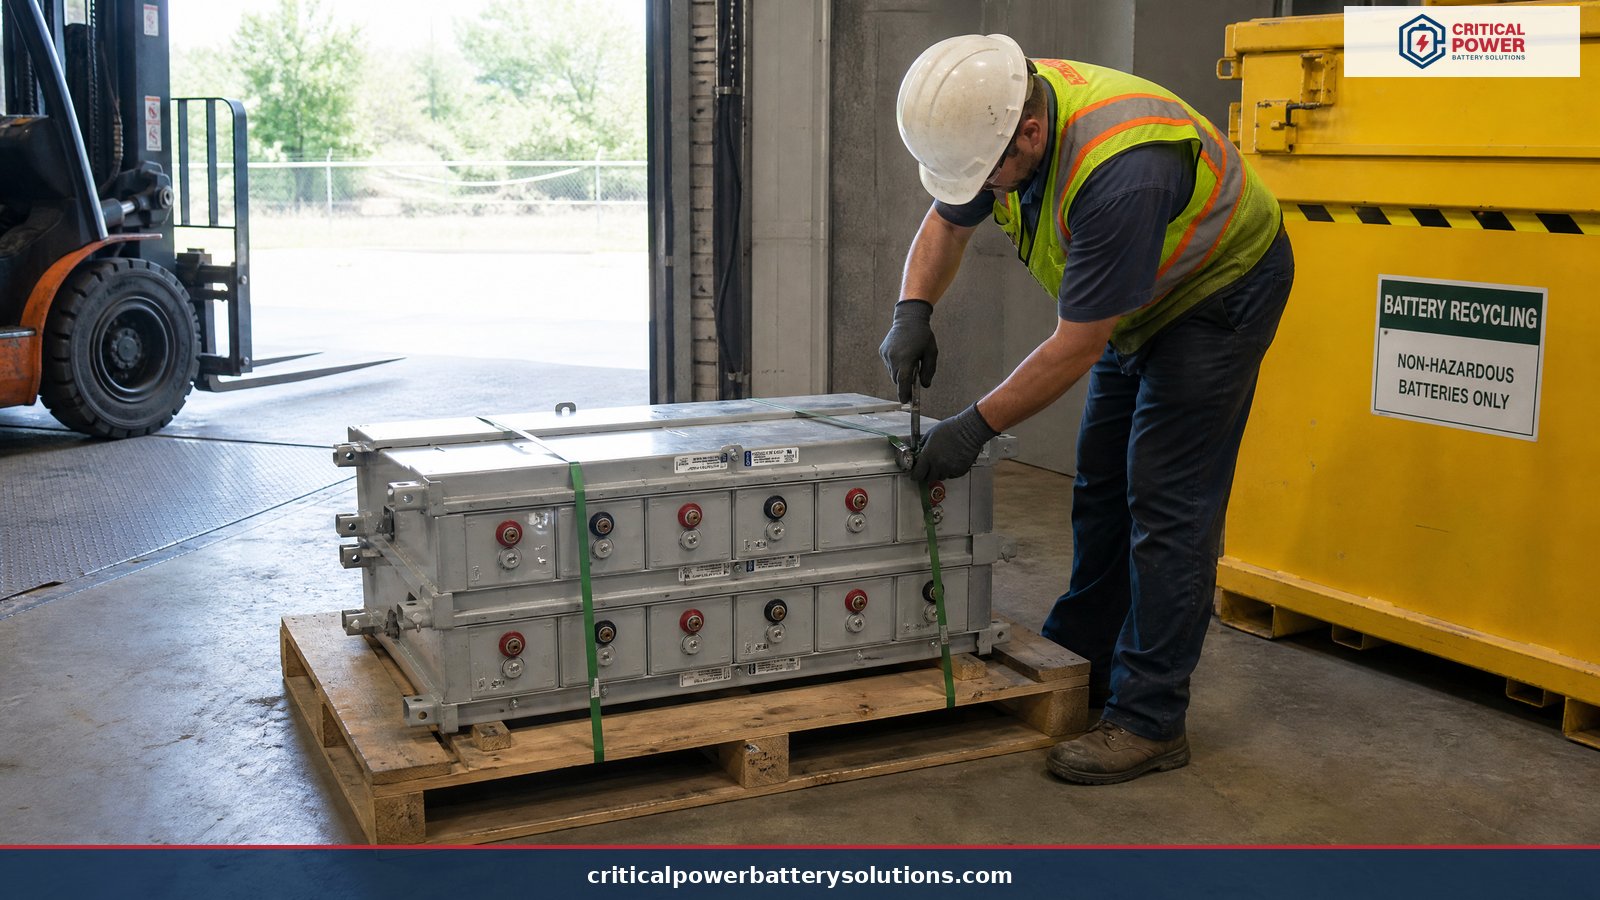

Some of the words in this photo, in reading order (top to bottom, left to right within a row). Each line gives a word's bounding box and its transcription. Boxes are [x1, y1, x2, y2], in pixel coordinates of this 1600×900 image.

[1384, 294, 1447, 319] BATTERY
[1450, 300, 1537, 329] RECYCLING
[1397, 353, 1514, 383] NON-HAZARDOUS
[1398, 379, 1469, 404] BATTERIES
[1473, 390, 1510, 409] ONLY
